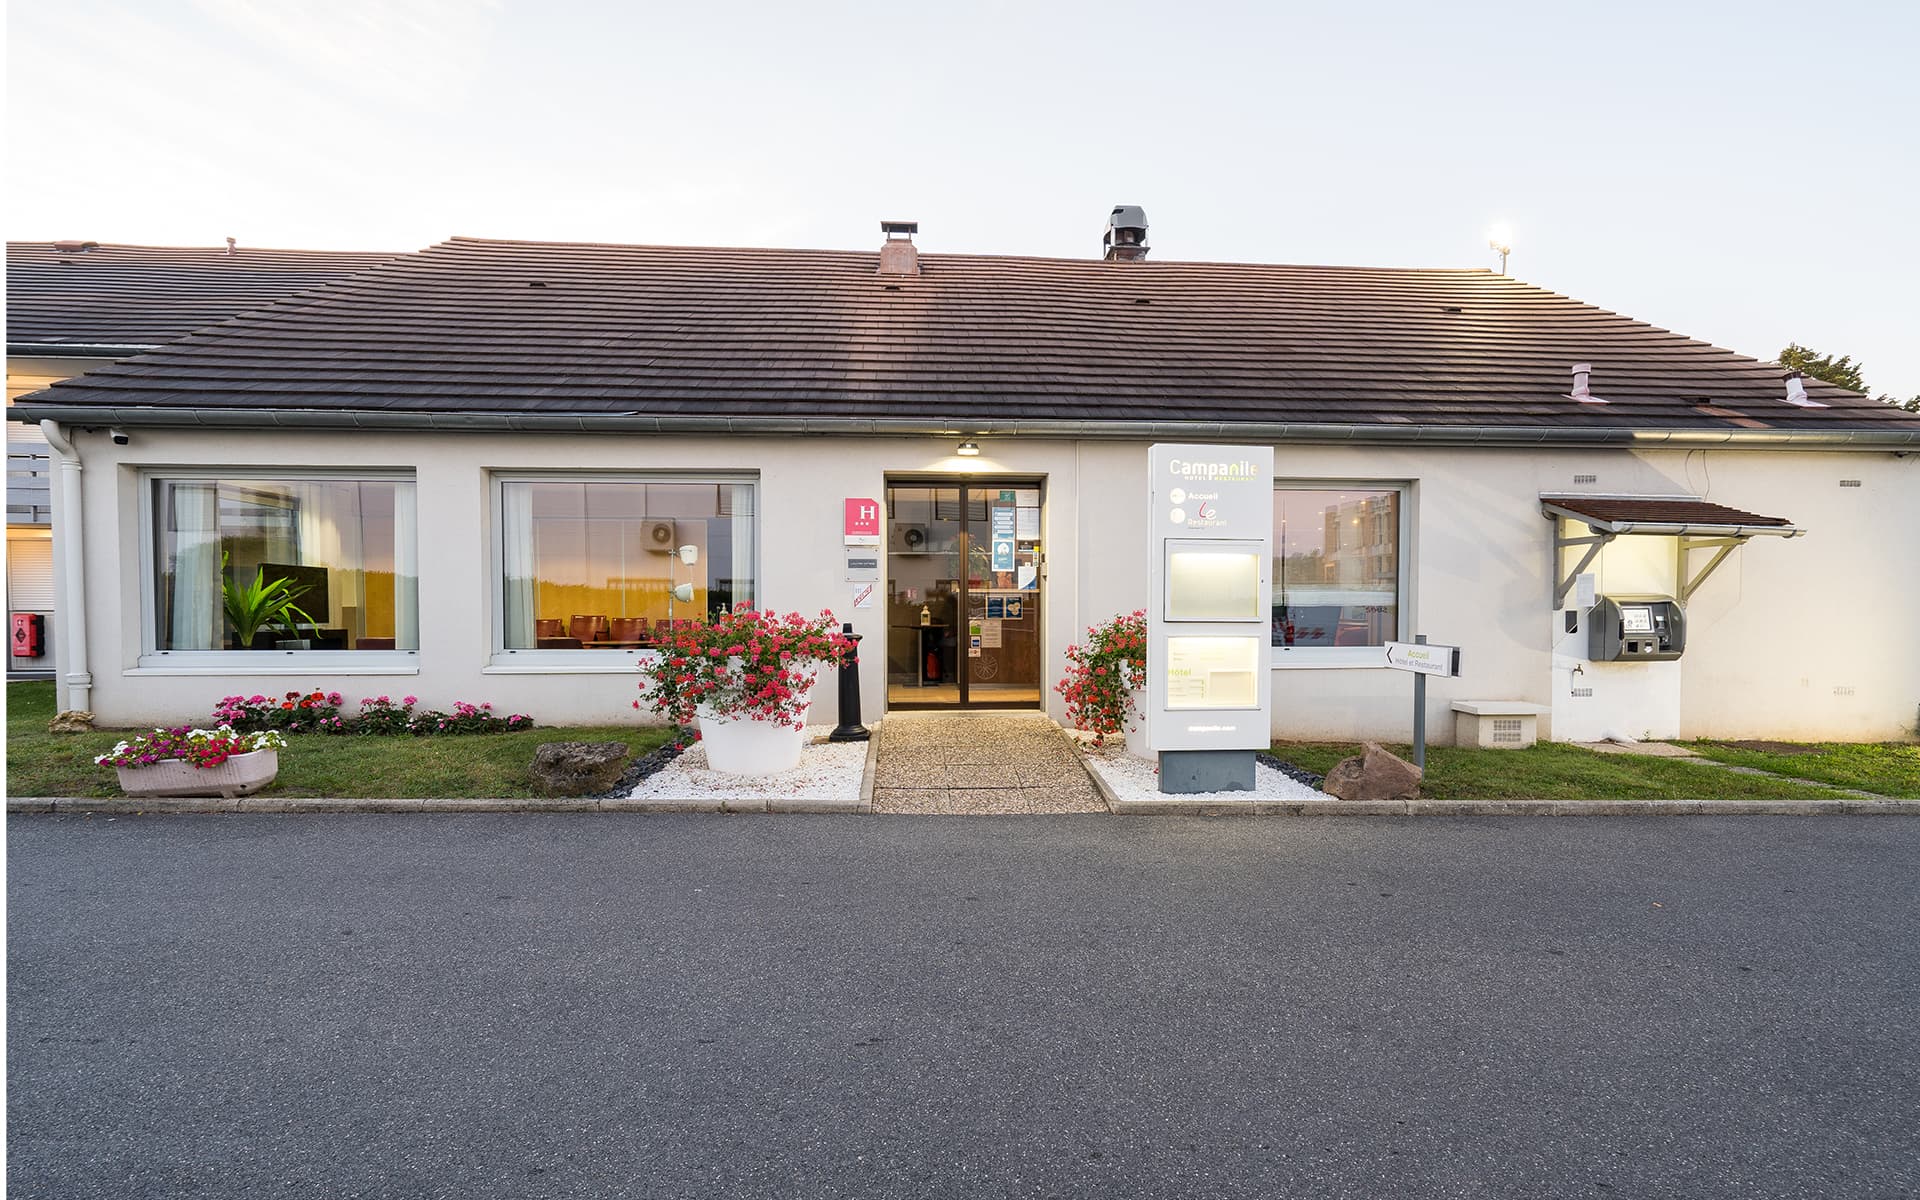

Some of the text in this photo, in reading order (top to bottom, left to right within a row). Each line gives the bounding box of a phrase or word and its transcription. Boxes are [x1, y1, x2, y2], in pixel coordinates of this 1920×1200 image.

[1169, 459, 1259, 480] Campanile
[1188, 492, 1219, 501] Accueil
[860, 505, 875, 520] H
[1407, 650, 1430, 659] Accueil
